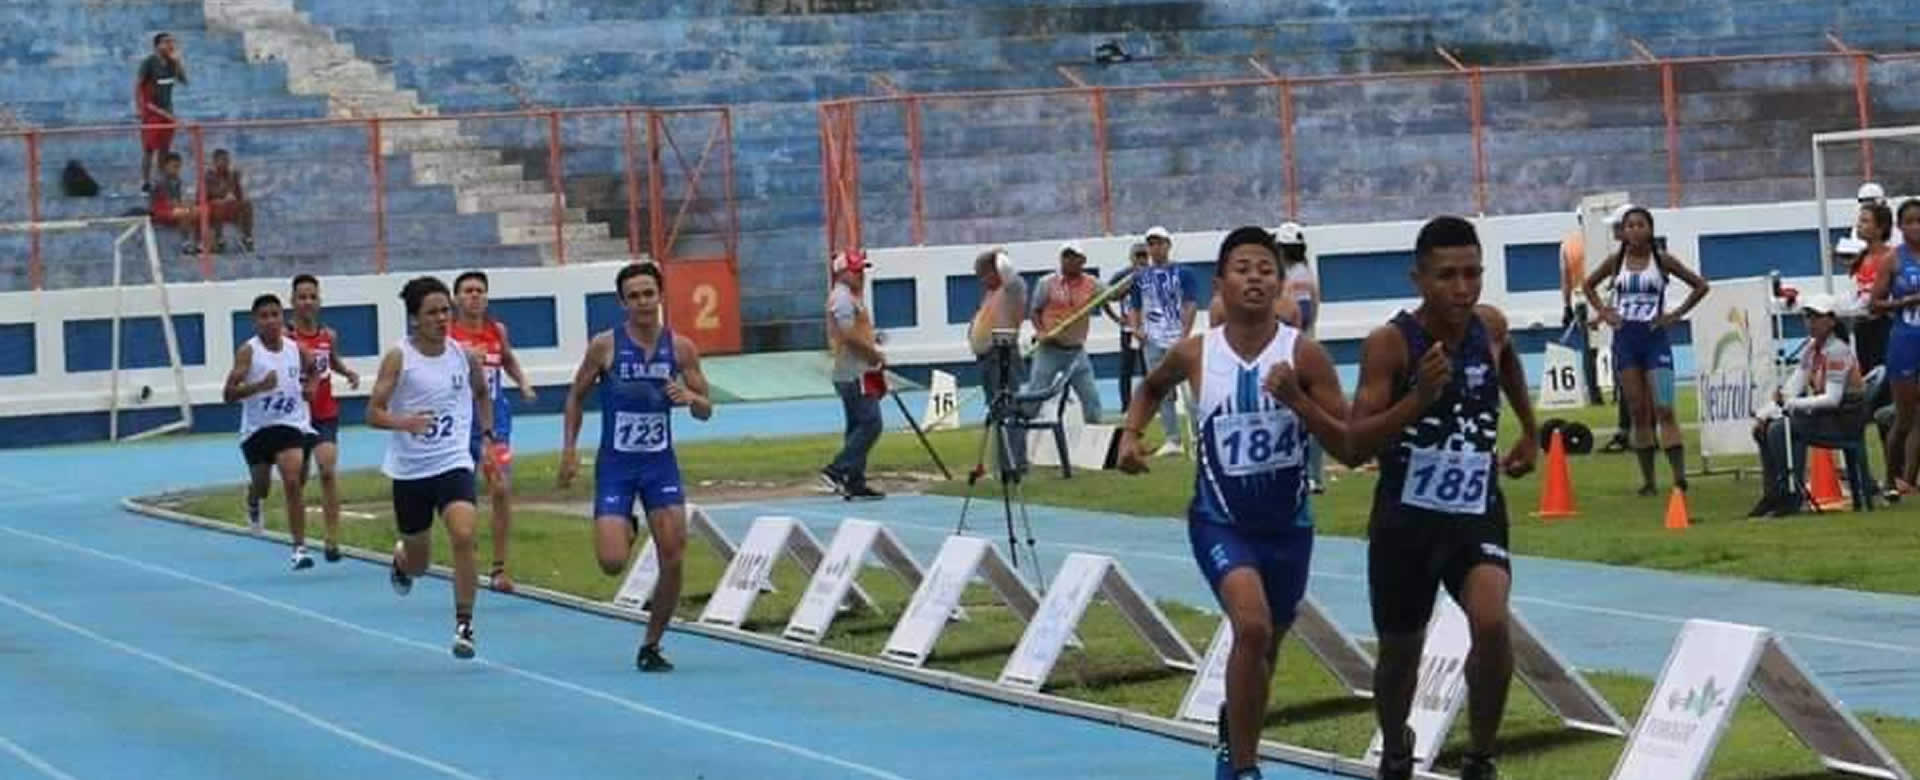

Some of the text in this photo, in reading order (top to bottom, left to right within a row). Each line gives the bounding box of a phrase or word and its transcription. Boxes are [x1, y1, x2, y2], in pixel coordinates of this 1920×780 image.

[692, 284, 720, 328] 2
[1547, 366, 1576, 391] 16
[934, 393, 954, 416] 16
[618, 422, 666, 446] 123
[1222, 420, 1297, 465] 184
[1413, 464, 1486, 502] 185
